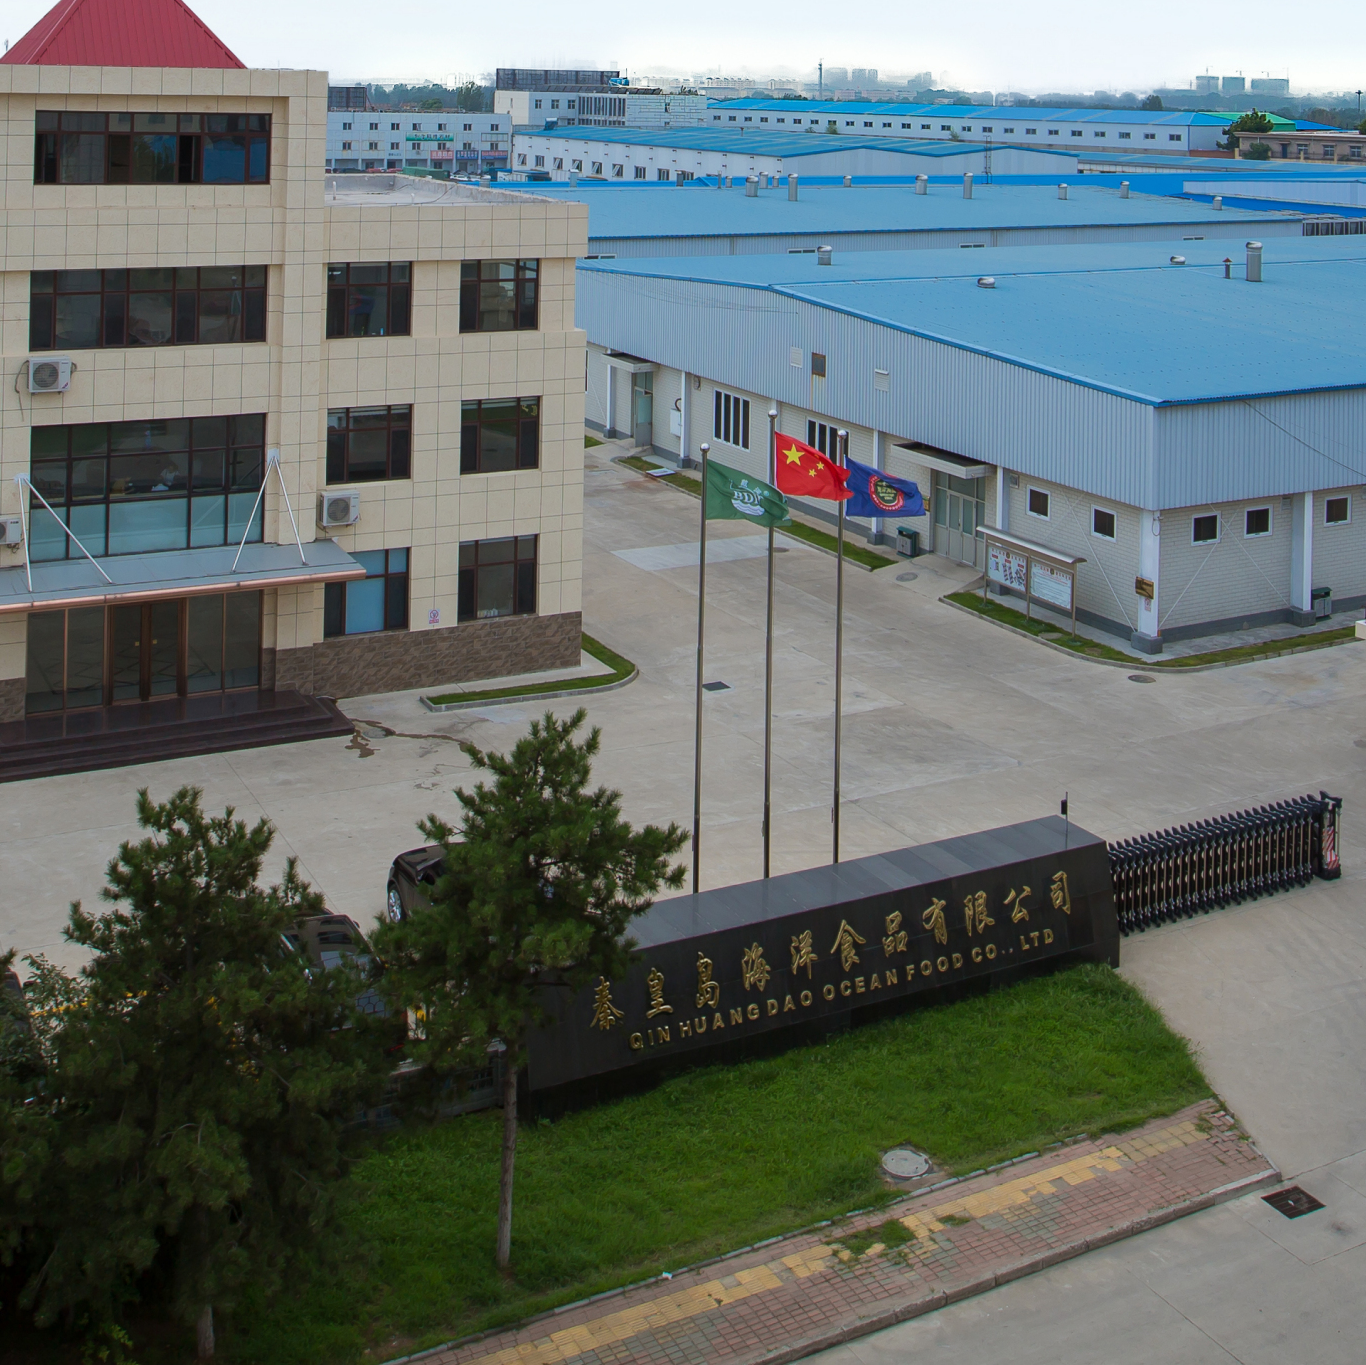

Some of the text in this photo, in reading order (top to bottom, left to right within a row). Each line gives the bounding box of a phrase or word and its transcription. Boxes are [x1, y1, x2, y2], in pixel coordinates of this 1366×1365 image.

[590, 870, 1071, 1031] 秦皇岛海洋食品有限公司
[628, 1025, 671, 1051] QIN
[822, 969, 898, 1001] OCEAN
[906, 953, 963, 982] FOOD
[1019, 928, 1054, 951] LTD
